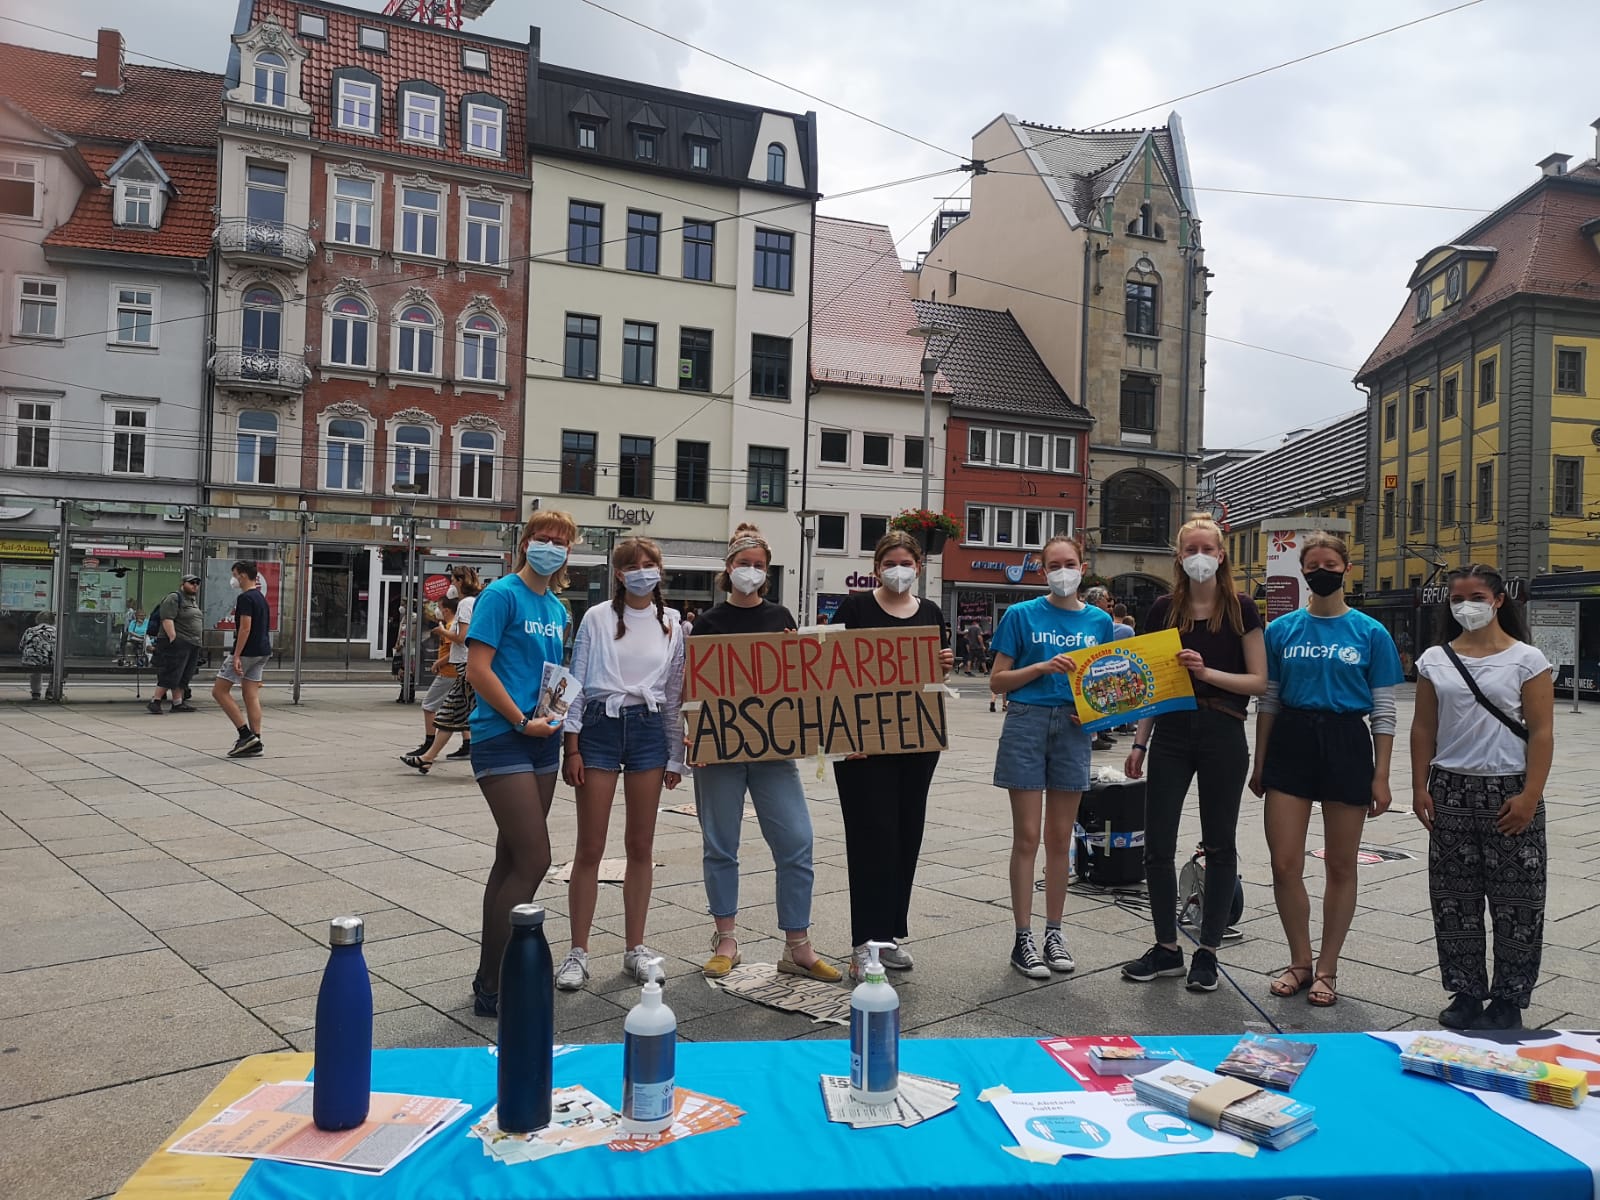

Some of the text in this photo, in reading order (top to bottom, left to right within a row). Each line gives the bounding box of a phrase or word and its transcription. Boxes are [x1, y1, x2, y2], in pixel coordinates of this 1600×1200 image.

[608, 503, 654, 523] liberty
[1422, 587, 1449, 604] ERFUR
[1032, 629, 1083, 647] unicef
[1283, 641, 1338, 659] unicef
[690, 636, 940, 698] KINDERARBEIT
[692, 690, 948, 761] ABSCHAFFEN
[797, 998, 851, 1019] KIN
